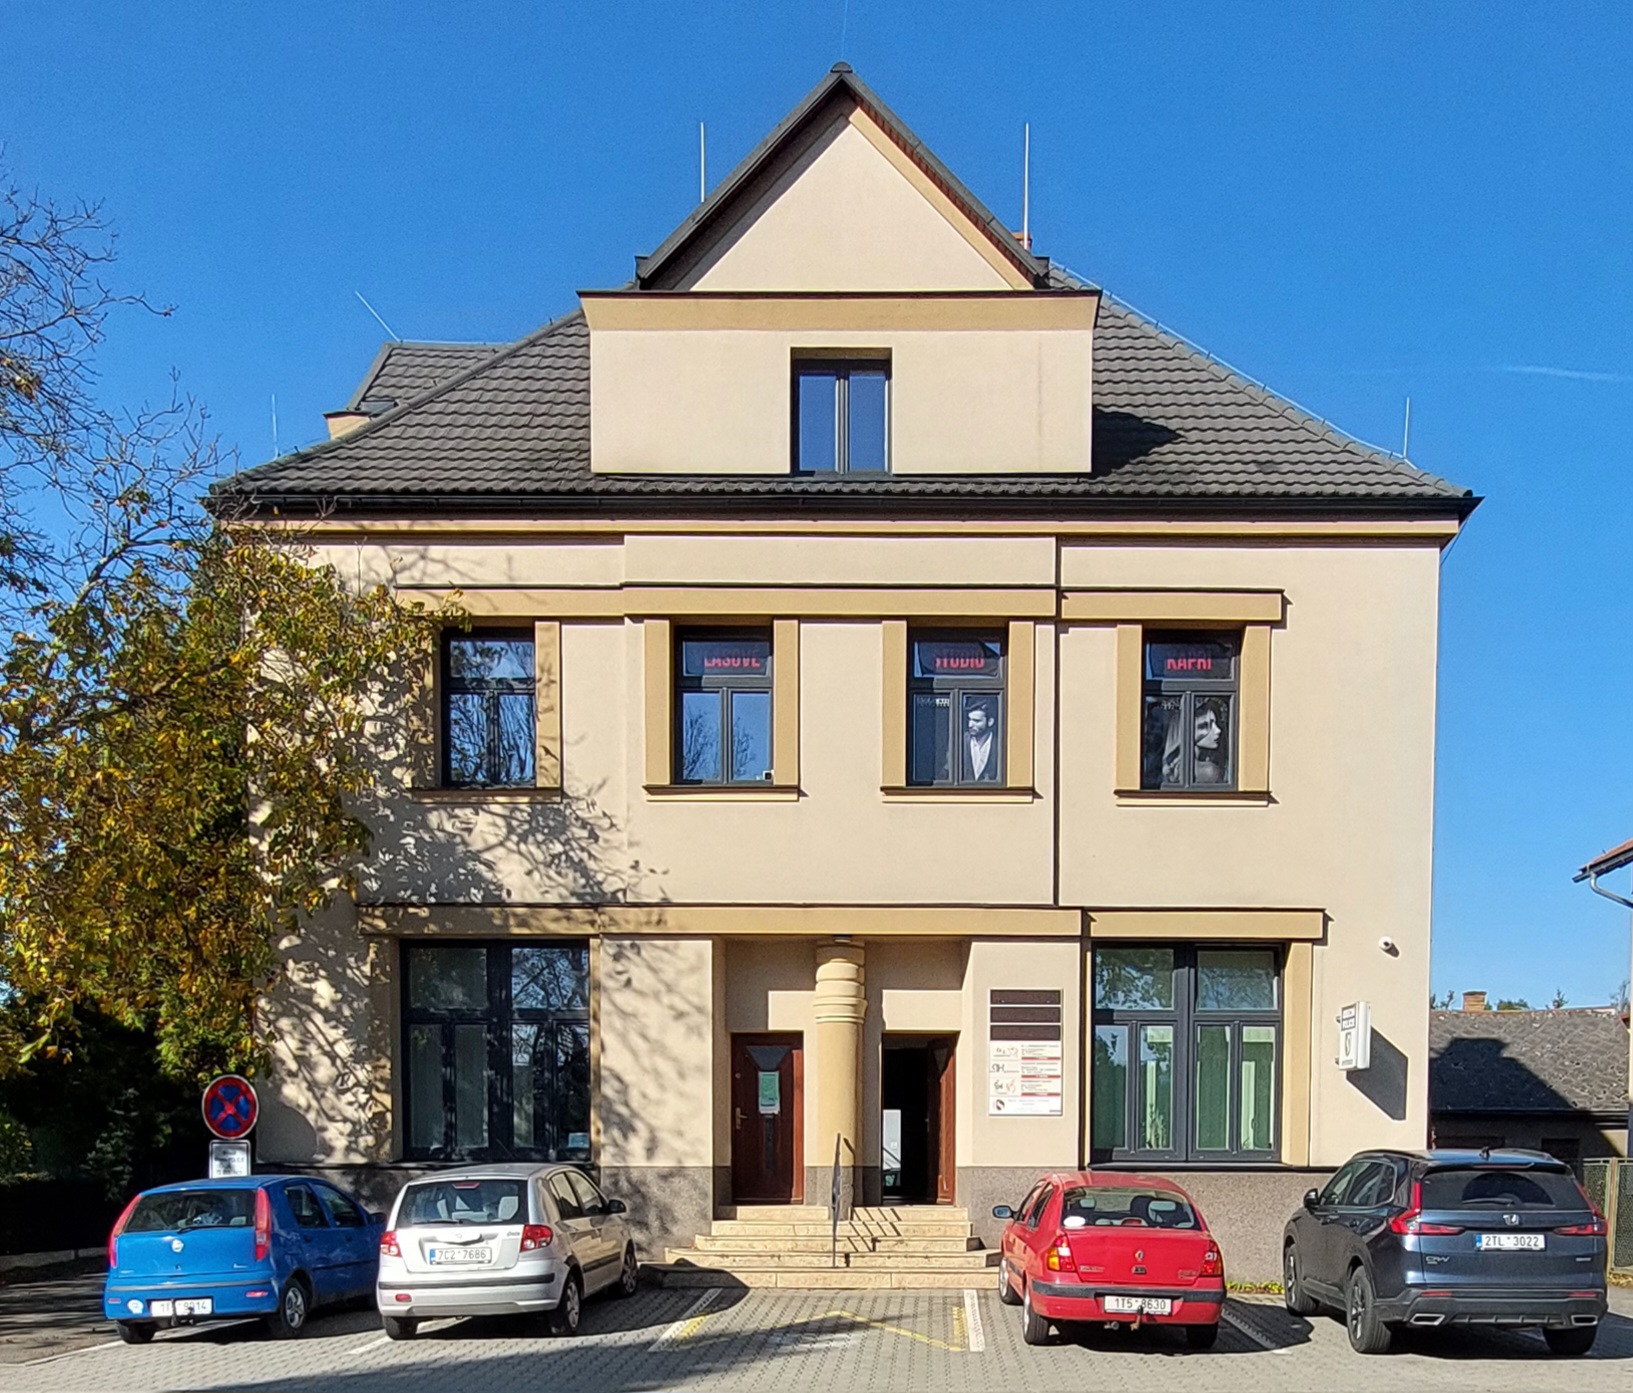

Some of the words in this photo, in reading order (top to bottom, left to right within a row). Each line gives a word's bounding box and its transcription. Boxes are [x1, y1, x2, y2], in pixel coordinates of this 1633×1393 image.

[1485, 1236, 1504, 1247] 2TL
[1513, 1236, 1539, 1247] 3022
[438, 1250, 456, 1261] 7C2
[463, 1249, 487, 1259] 7686
[1114, 1298, 1133, 1309] 1T5
[1141, 1299, 1167, 1310] 8630
